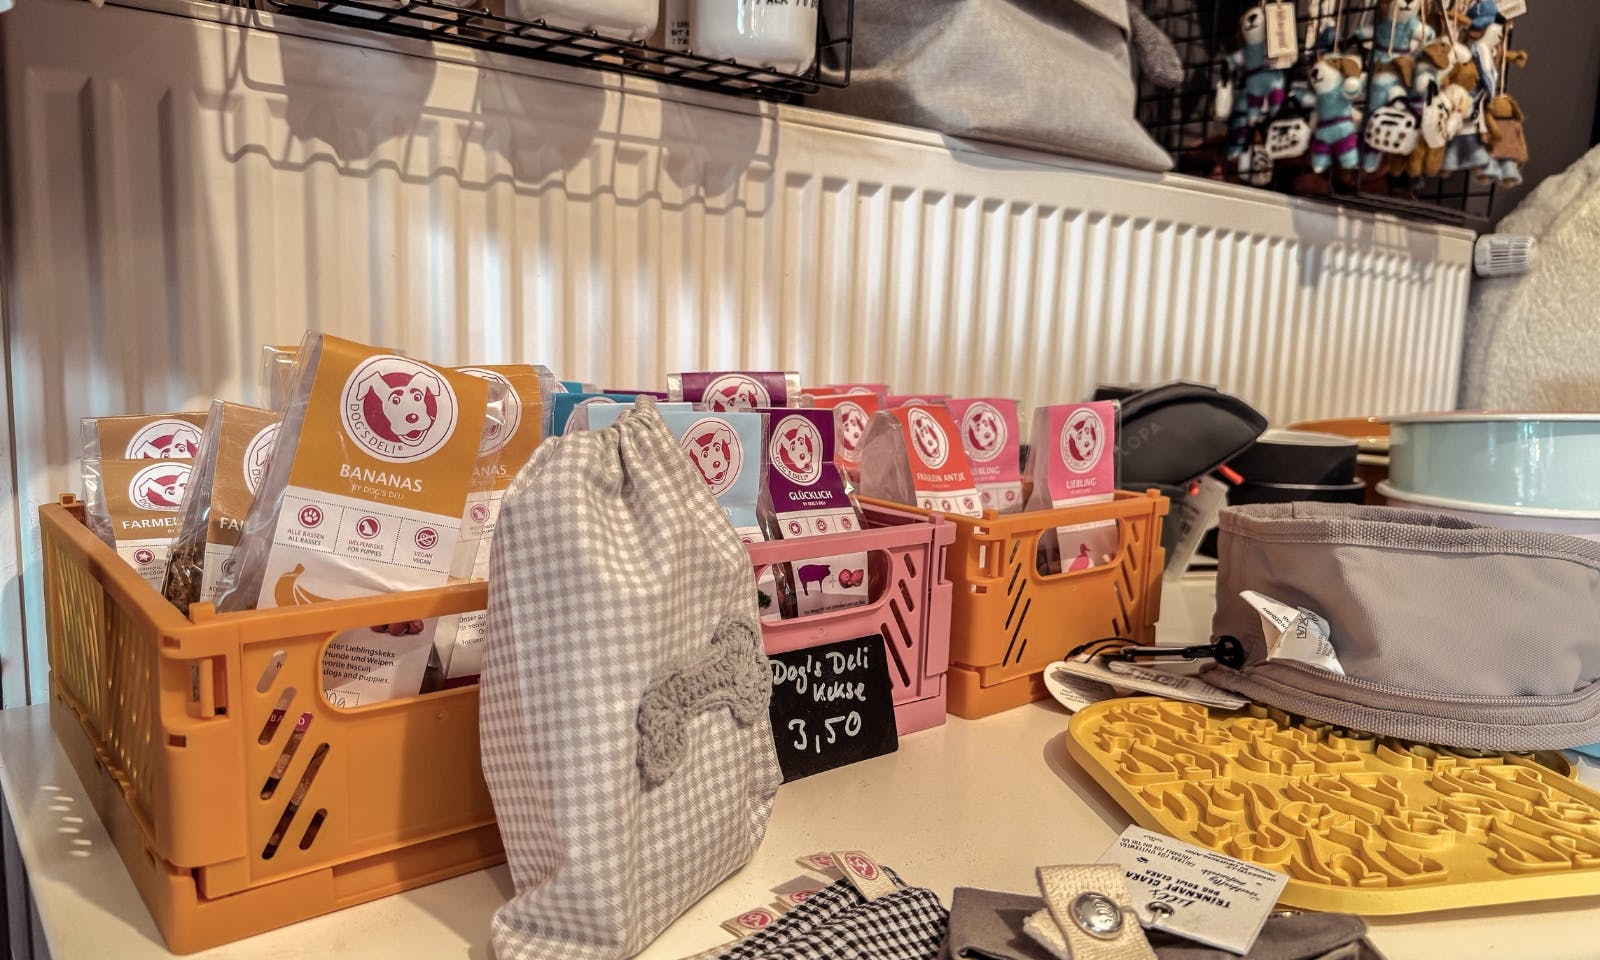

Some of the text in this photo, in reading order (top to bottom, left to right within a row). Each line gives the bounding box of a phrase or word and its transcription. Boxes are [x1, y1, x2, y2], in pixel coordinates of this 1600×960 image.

[350, 403, 371, 439] DOG'S
[339, 463, 423, 492] BANANAS
[472, 464, 507, 478] ANAS
[363, 486, 387, 497] DOG'S
[788, 489, 833, 501] GLÜCKLICH
[287, 528, 325, 540] ALLE RASSEN
[288, 535, 298, 543] ALL
[347, 546, 383, 557] FOR PUPPIES
[414, 551, 433, 559] VEGAN
[412, 557, 432, 566] VEGAN
[1262, 607, 1283, 625] GERMANY
[325, 650, 350, 660] Hunde
[351, 655, 367, 663] und
[345, 645, 395, 658] Lieblingskeks
[323, 660, 371, 673] vorite biscuit
[770, 646, 868, 694] Dog's Deli
[323, 668, 342, 678] dogs
[343, 671, 359, 680] and
[788, 710, 862, 754] 3,50
[1126, 871, 1161, 886] CLARA
[1145, 869, 1221, 896] DOG BOWL CLARA
